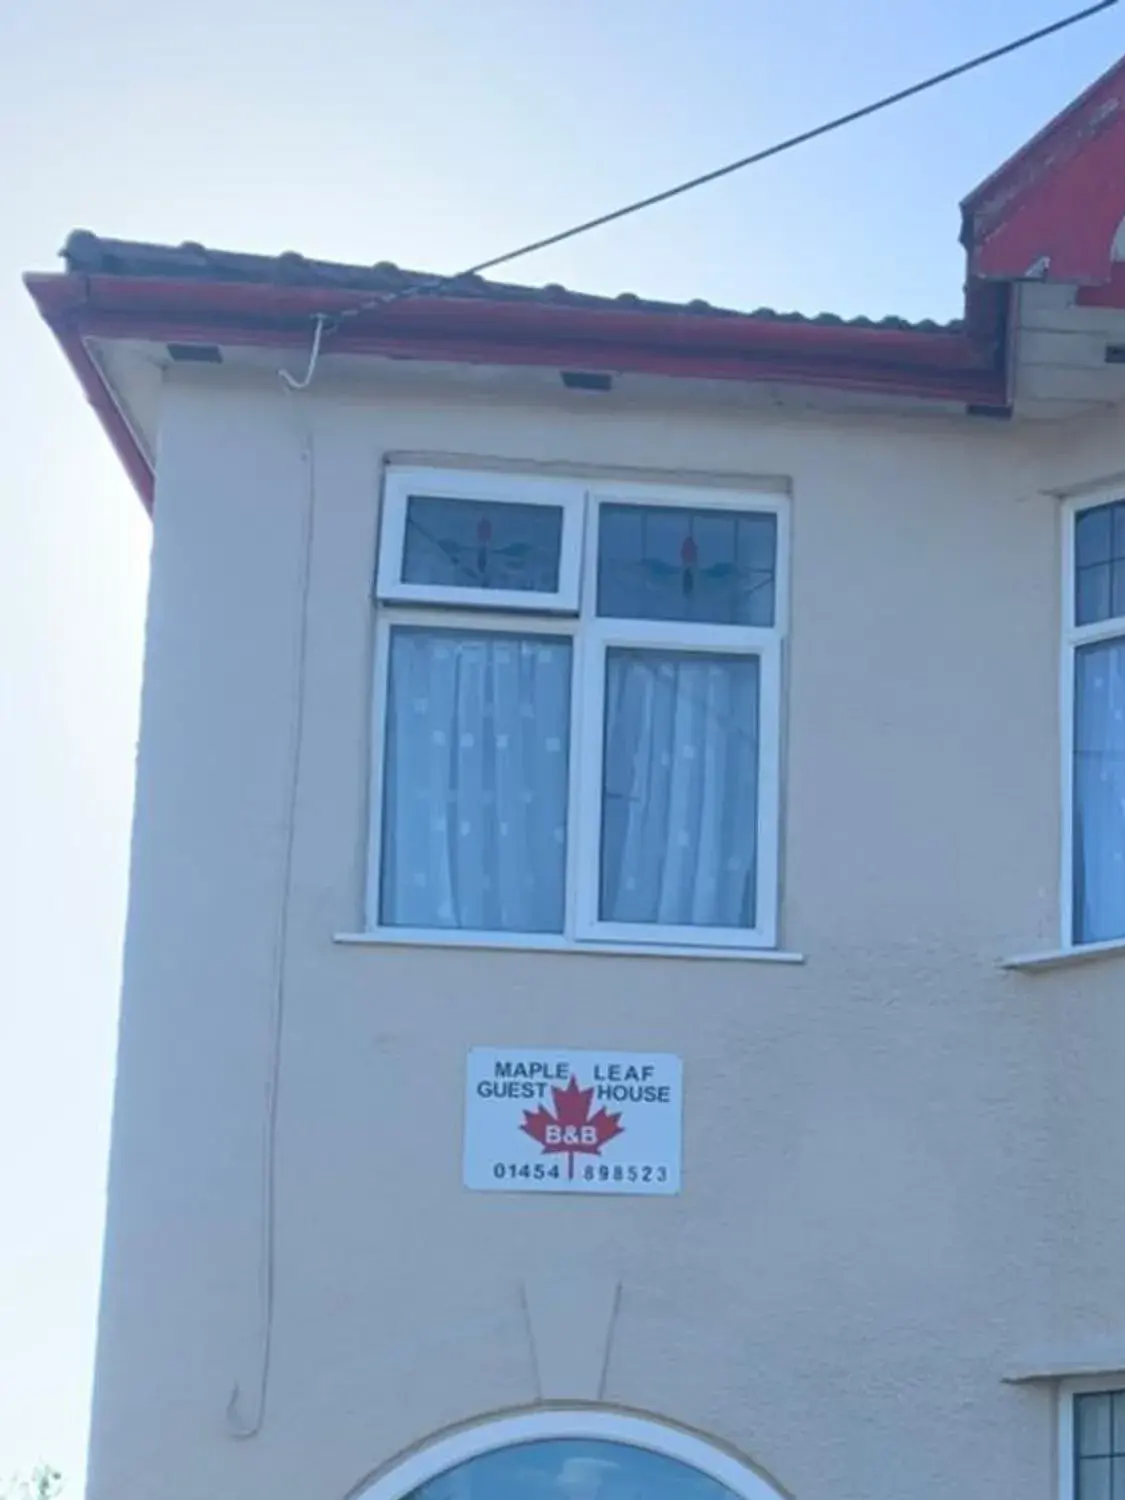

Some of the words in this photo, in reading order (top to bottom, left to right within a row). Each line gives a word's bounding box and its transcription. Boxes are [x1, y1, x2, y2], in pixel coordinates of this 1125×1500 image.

[494, 1062, 569, 1080] MAPLE
[594, 1064, 655, 1082] LEAF
[477, 1081, 548, 1099] GUEST
[597, 1085, 671, 1103] HOUSE
[545, 1125, 597, 1145] B&B
[493, 1162, 560, 1180] 01454
